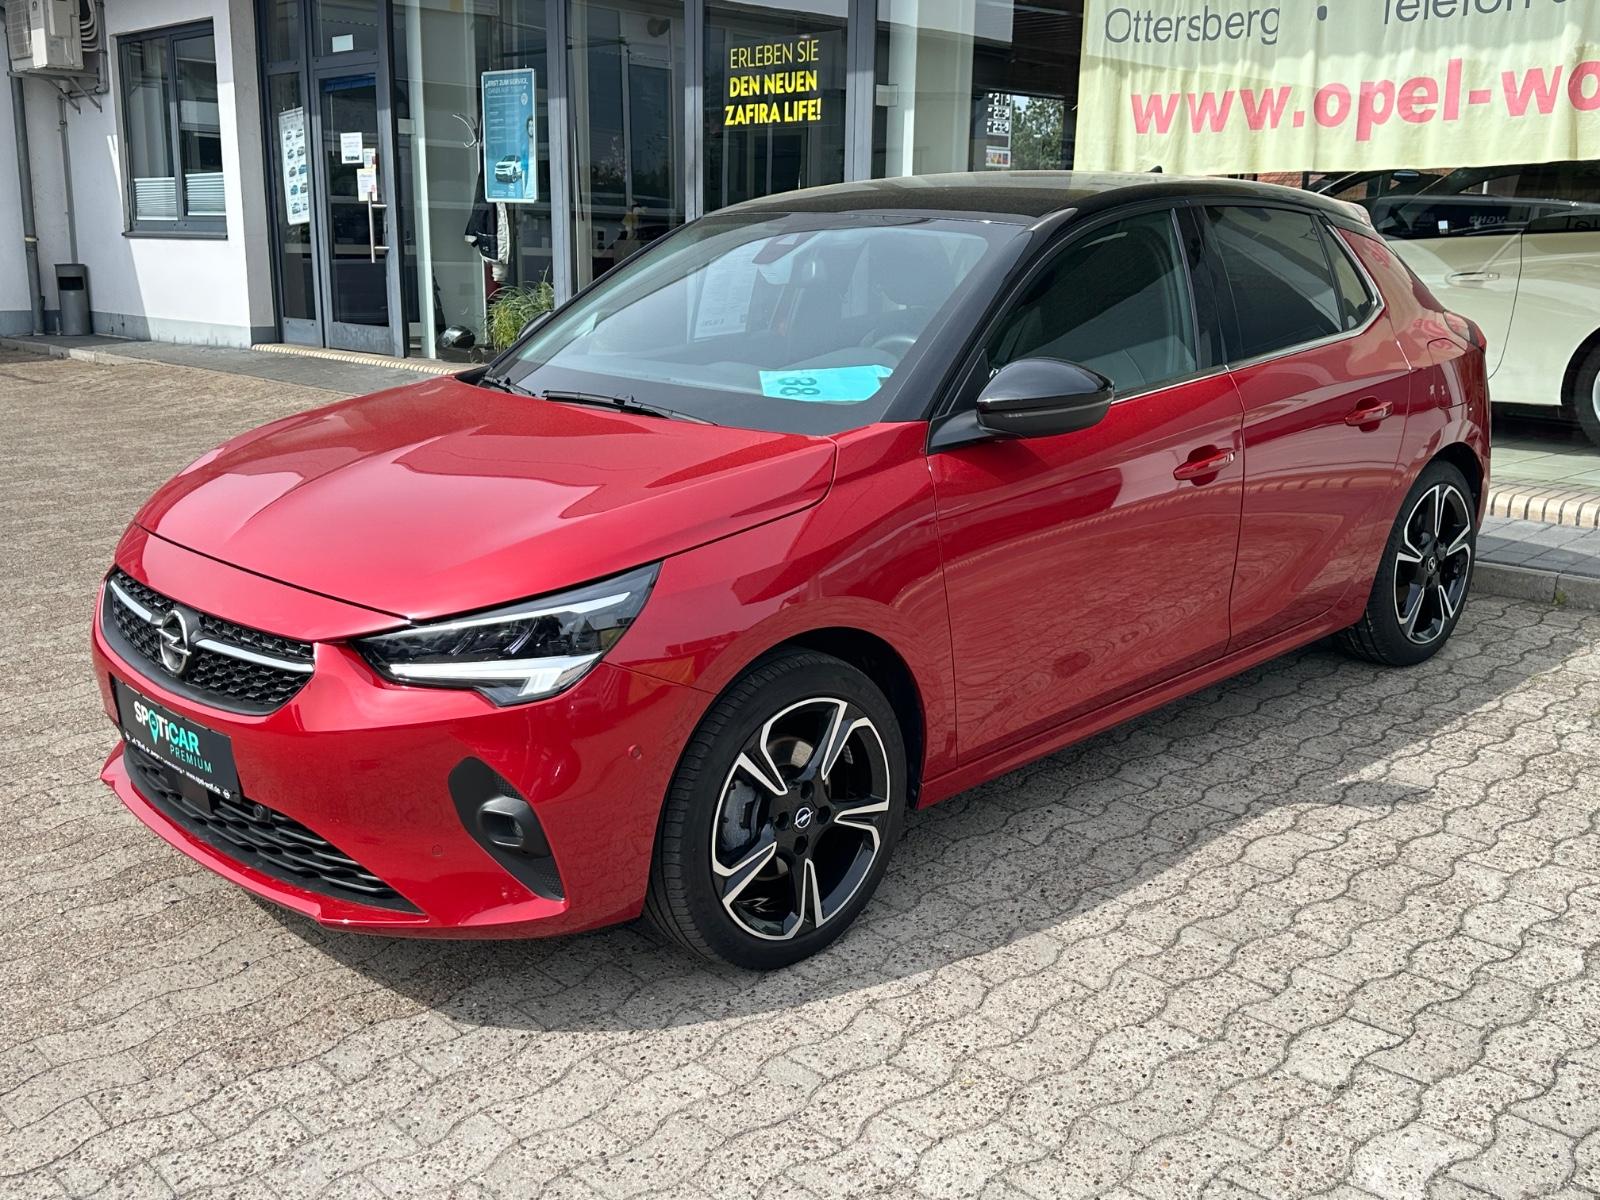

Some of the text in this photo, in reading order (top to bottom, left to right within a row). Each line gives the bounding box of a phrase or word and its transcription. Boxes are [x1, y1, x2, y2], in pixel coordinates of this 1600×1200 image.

[1105, 0, 1532, 45] Ottersberg Tele
[730, 39, 820, 69] ERLEBEN SIE
[729, 69, 818, 98] DEN NEUEN
[724, 97, 822, 126] ZAFIRA LIFE!
[1131, 58, 1600, 141] www.opel-wo
[777, 376, 821, 396] 38
[169, 744, 212, 774] PREMIUM
